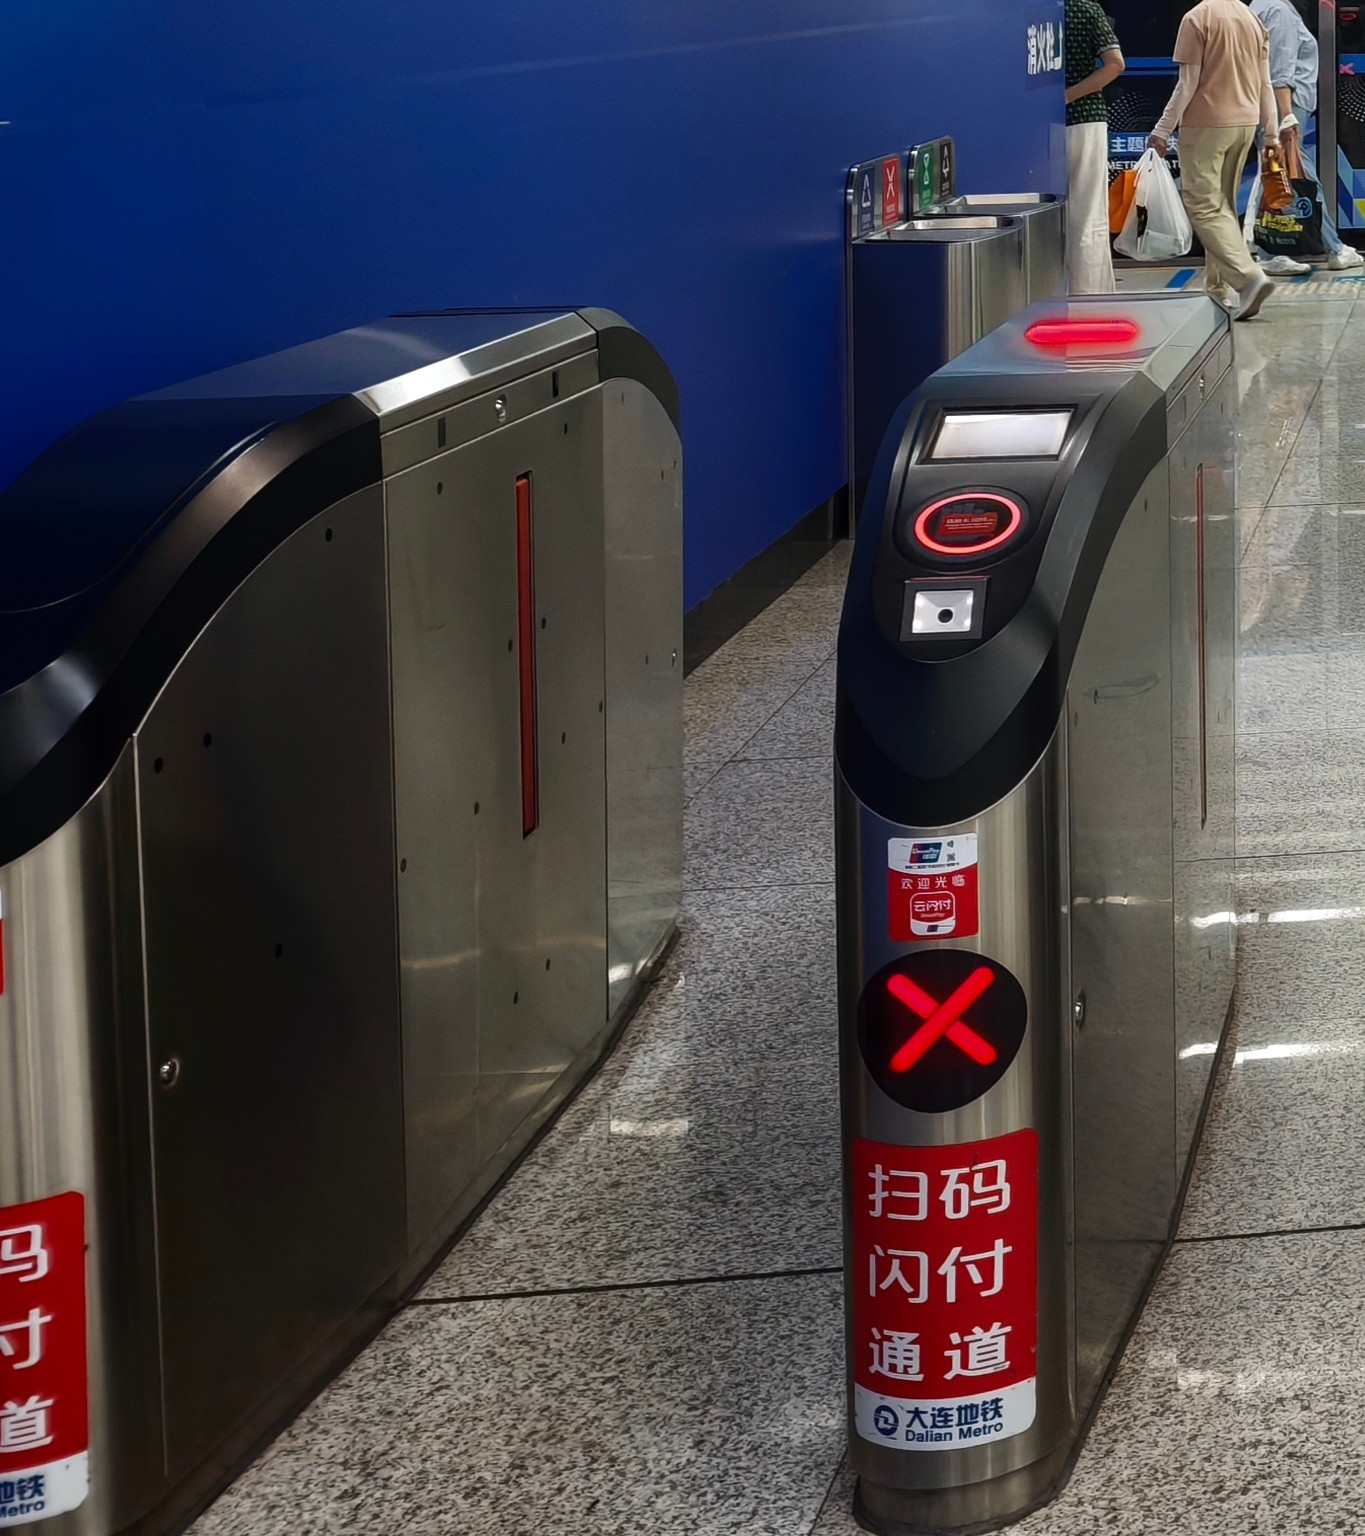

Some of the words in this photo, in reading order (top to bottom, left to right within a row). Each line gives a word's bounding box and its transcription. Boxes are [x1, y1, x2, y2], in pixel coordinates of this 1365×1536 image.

[868, 1159, 1011, 1221] 扫码
[869, 1240, 1012, 1304] 闪付
[869, 1322, 1012, 1382] 通道
[905, 1426, 954, 1444] Dalian
[958, 1421, 1004, 1440] Metro
[906, 1398, 1004, 1431] 大连地铁
[0, 1475, 44, 1505] 地铁
